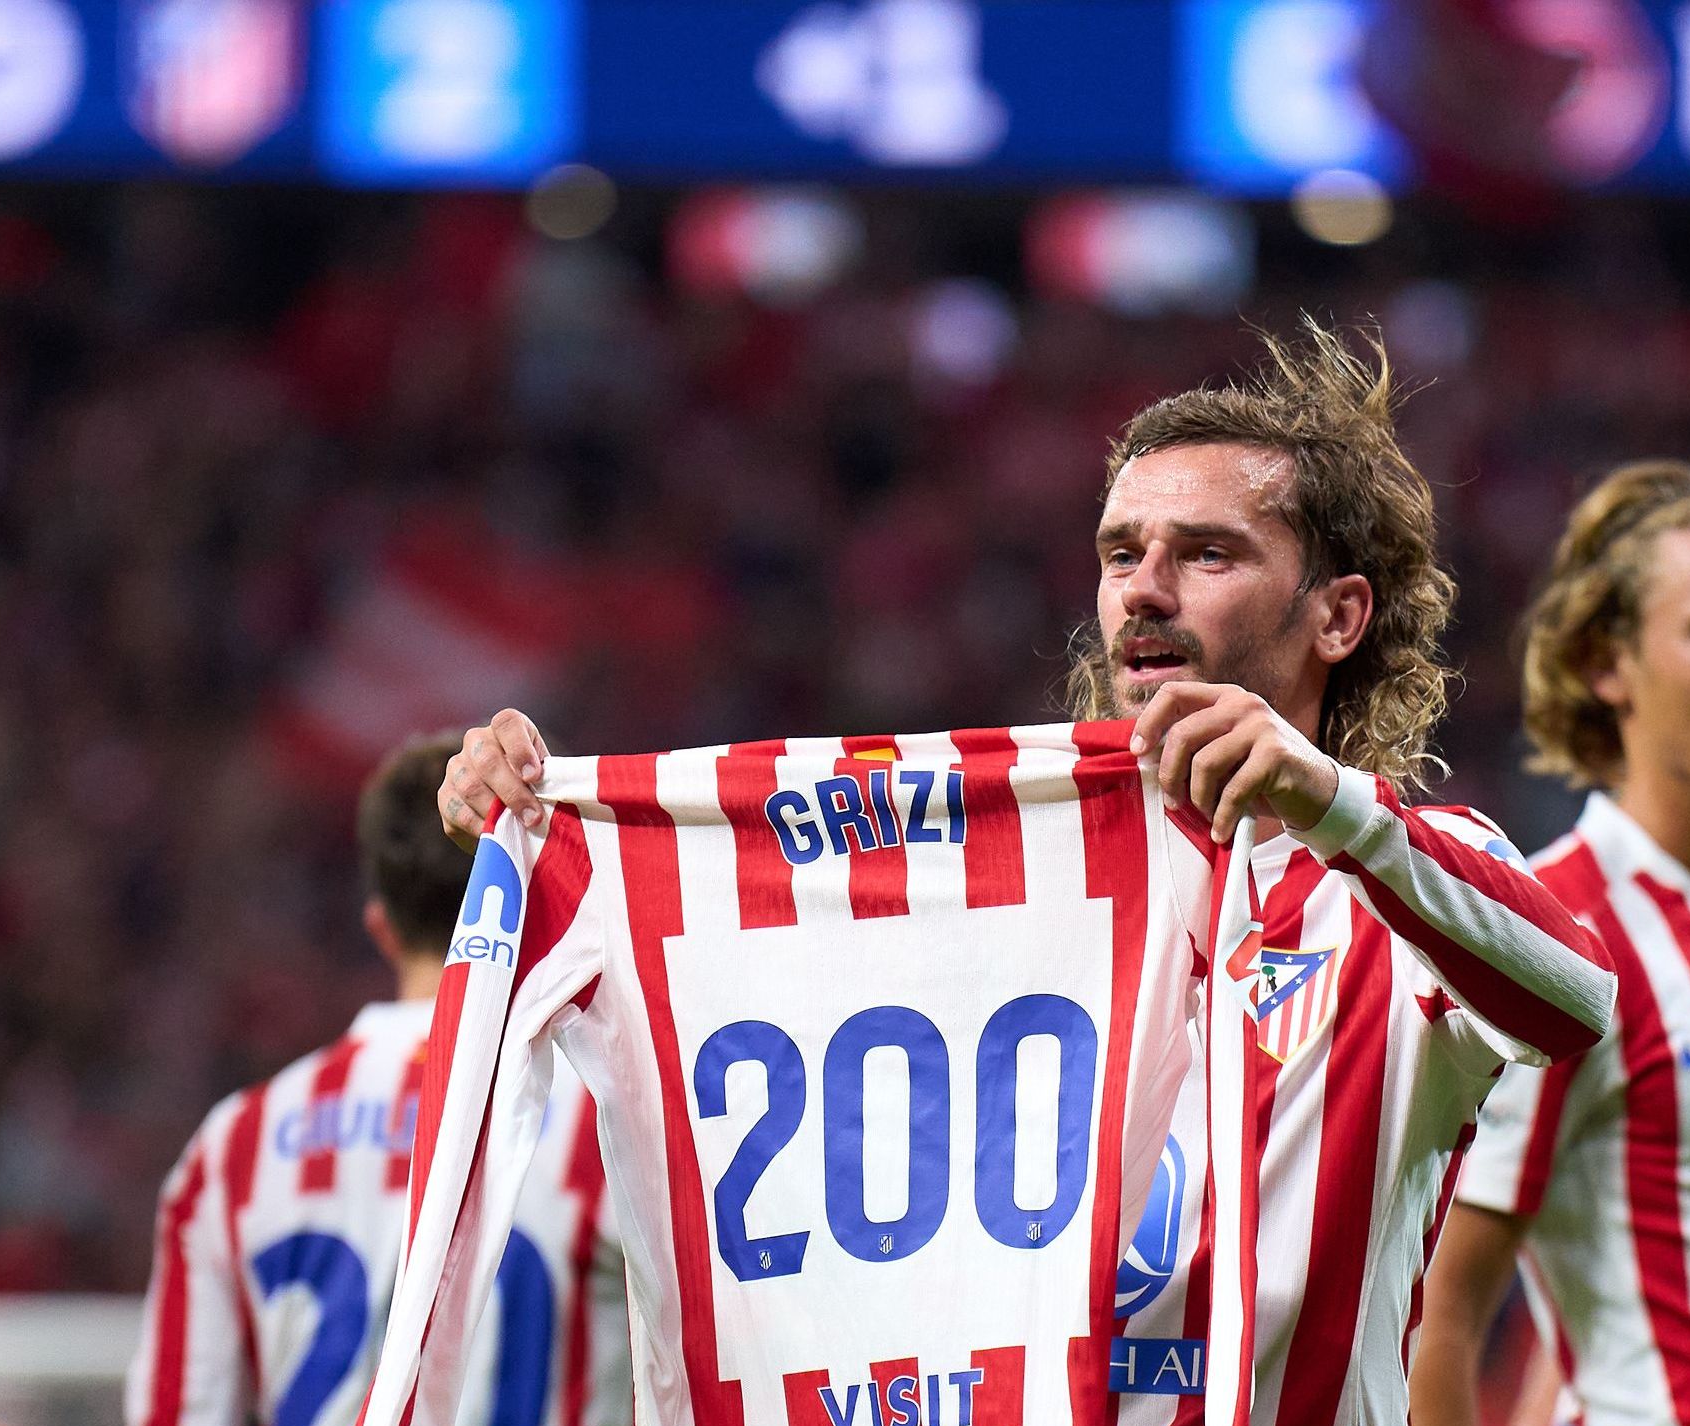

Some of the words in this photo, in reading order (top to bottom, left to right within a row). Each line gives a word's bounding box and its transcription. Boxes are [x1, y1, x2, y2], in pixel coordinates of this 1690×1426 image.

[764, 769, 966, 866] GRIZI
[693, 993, 1098, 1283] 200
[1152, 1346, 1207, 1387] AI
